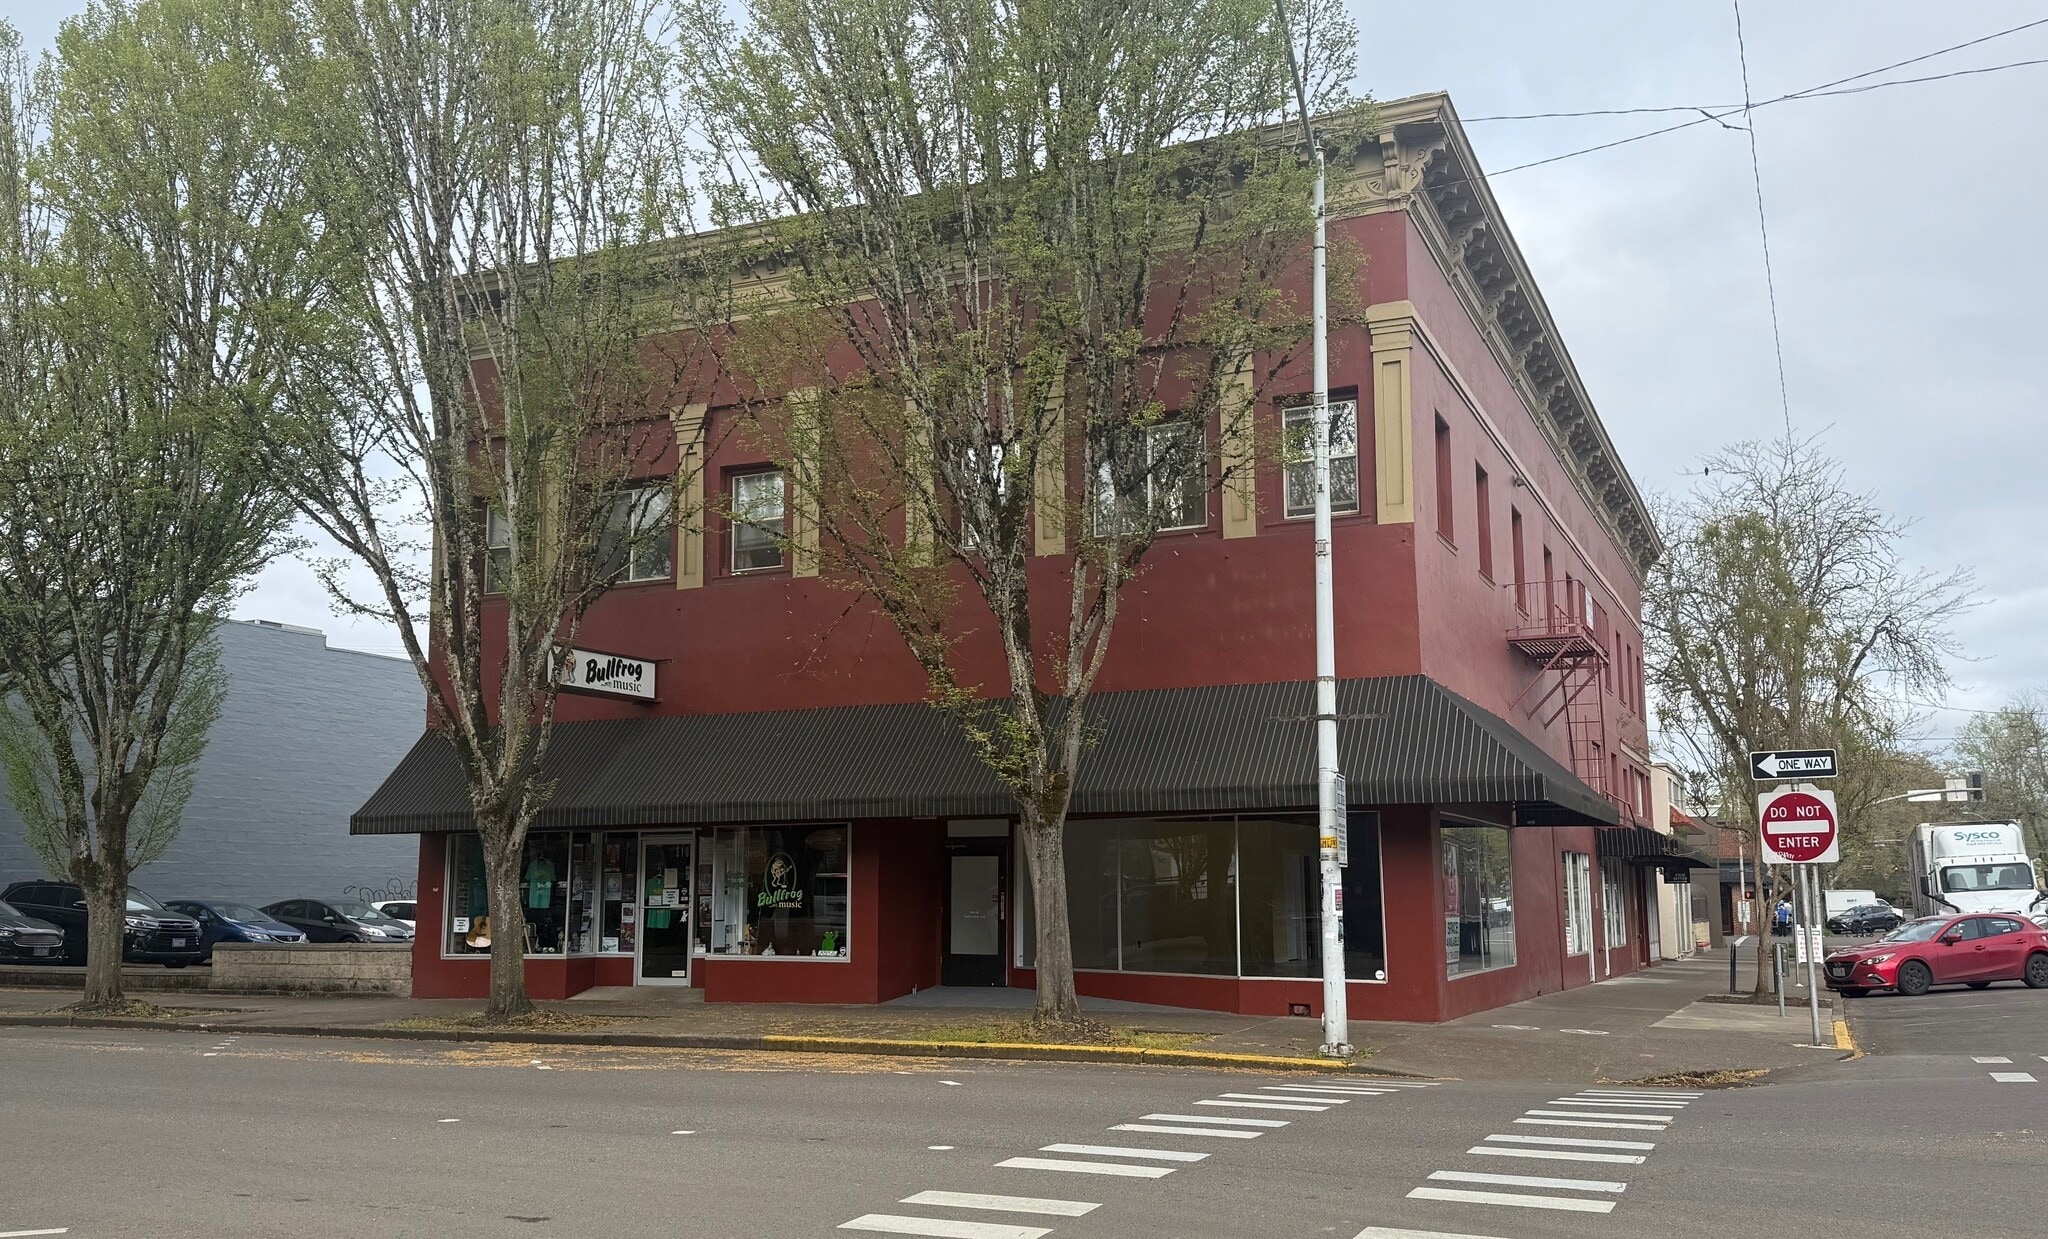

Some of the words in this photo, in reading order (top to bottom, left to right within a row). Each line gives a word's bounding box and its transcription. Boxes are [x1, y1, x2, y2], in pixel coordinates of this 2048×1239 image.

[585, 657, 642, 684] Bullfrog
[613, 680, 642, 692] music
[1778, 759, 1801, 770] ONE
[1803, 758, 1828, 769] WAY
[1770, 807, 1787, 818] DO
[1796, 805, 1821, 817] NOT
[1778, 836, 1820, 848] ENTER
[1954, 831, 1999, 841] Sysco
[676, 846, 690, 858] 310
[757, 889, 804, 907] Bullfrog
[778, 900, 803, 909] music
